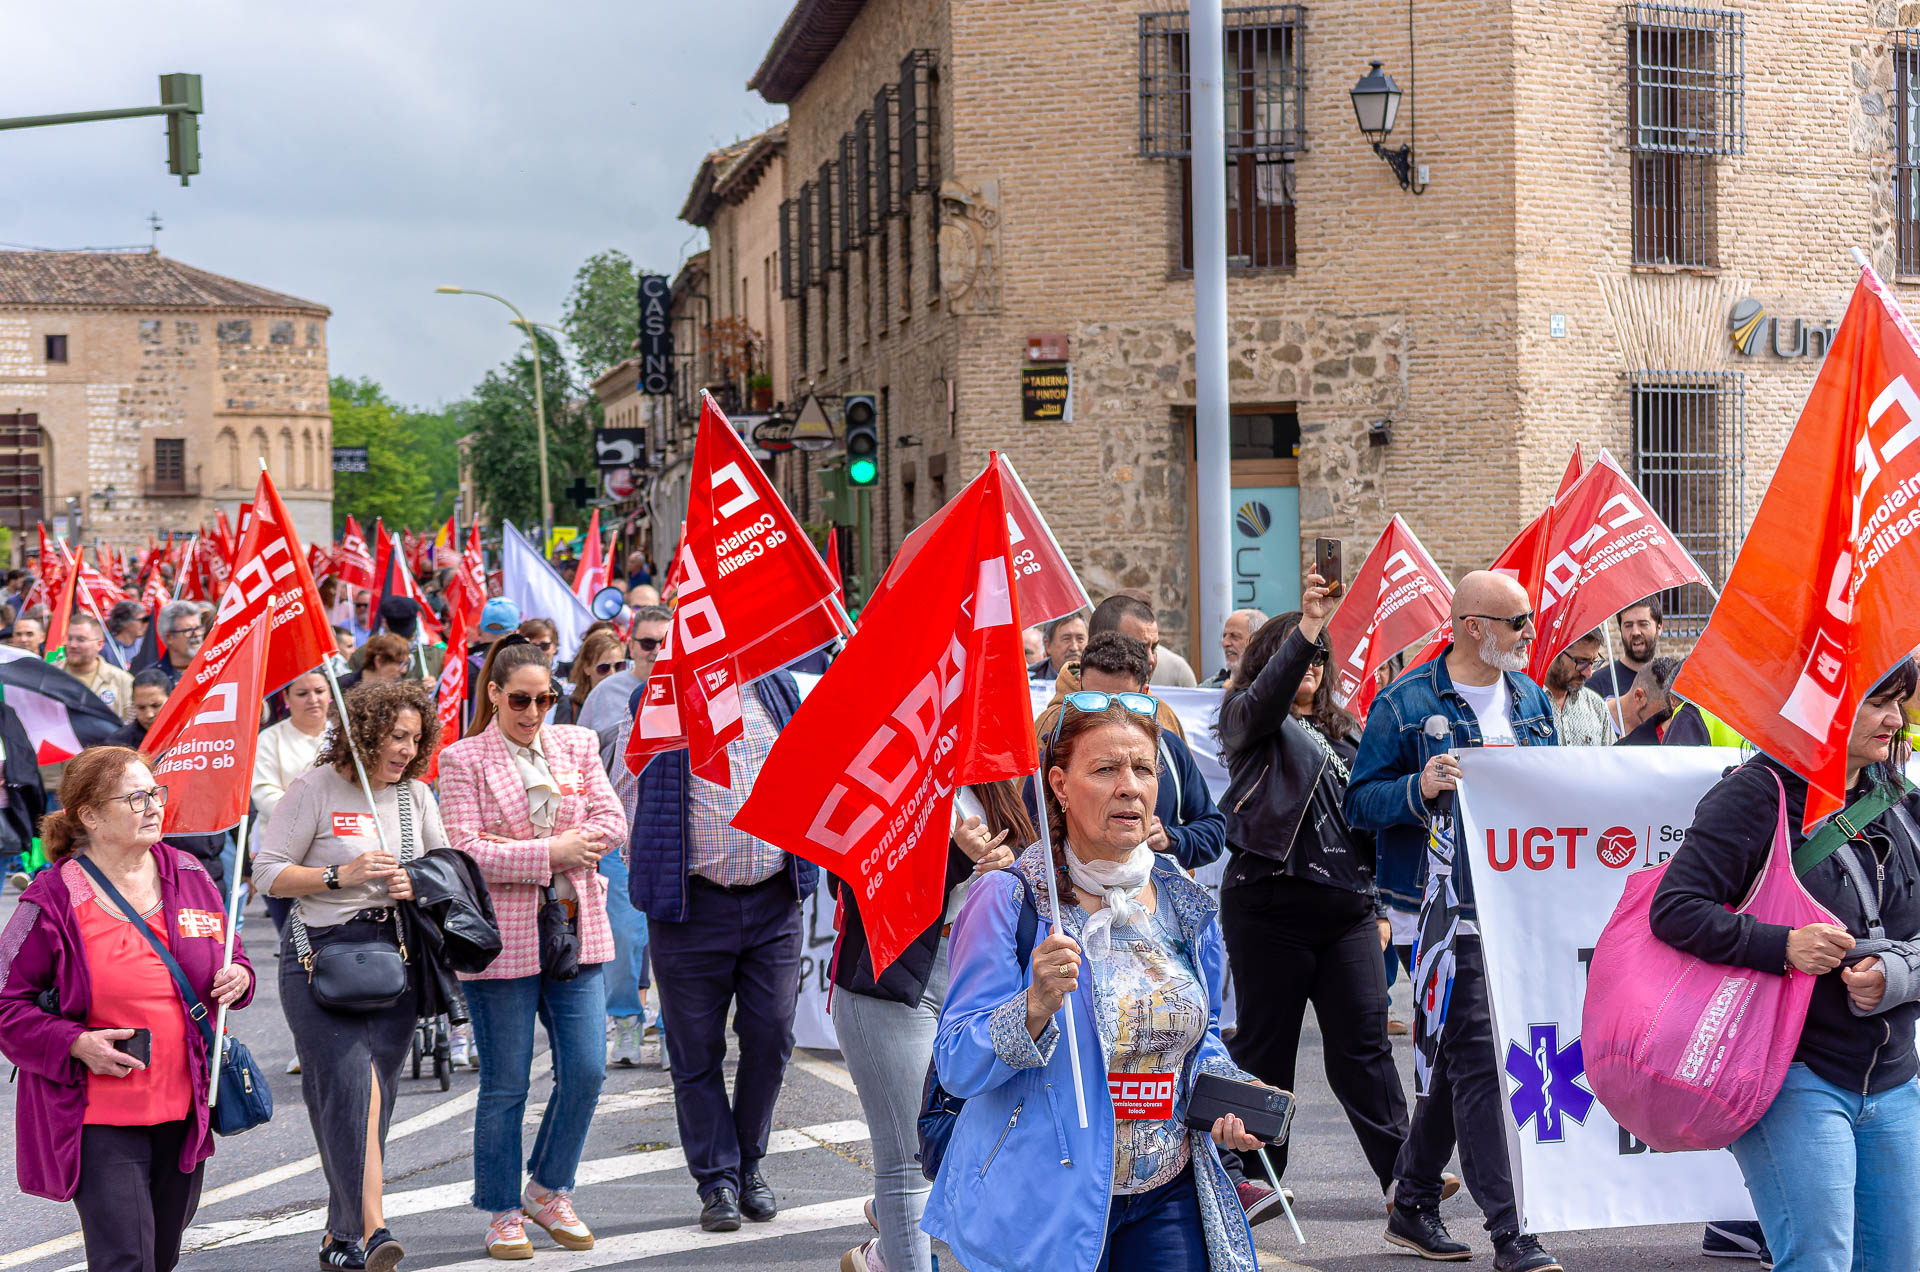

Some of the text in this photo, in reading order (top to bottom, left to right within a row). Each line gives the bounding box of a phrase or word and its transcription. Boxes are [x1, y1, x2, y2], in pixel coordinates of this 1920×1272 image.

[643, 278, 669, 393] CASINO
[1031, 376, 1068, 386] TABERNA
[1036, 389, 1067, 400] PINTOR
[861, 766, 933, 876] comisiones
[1486, 827, 1588, 872] UGT
[866, 871, 883, 900] de
[1681, 981, 1741, 1080] DECATHLON
